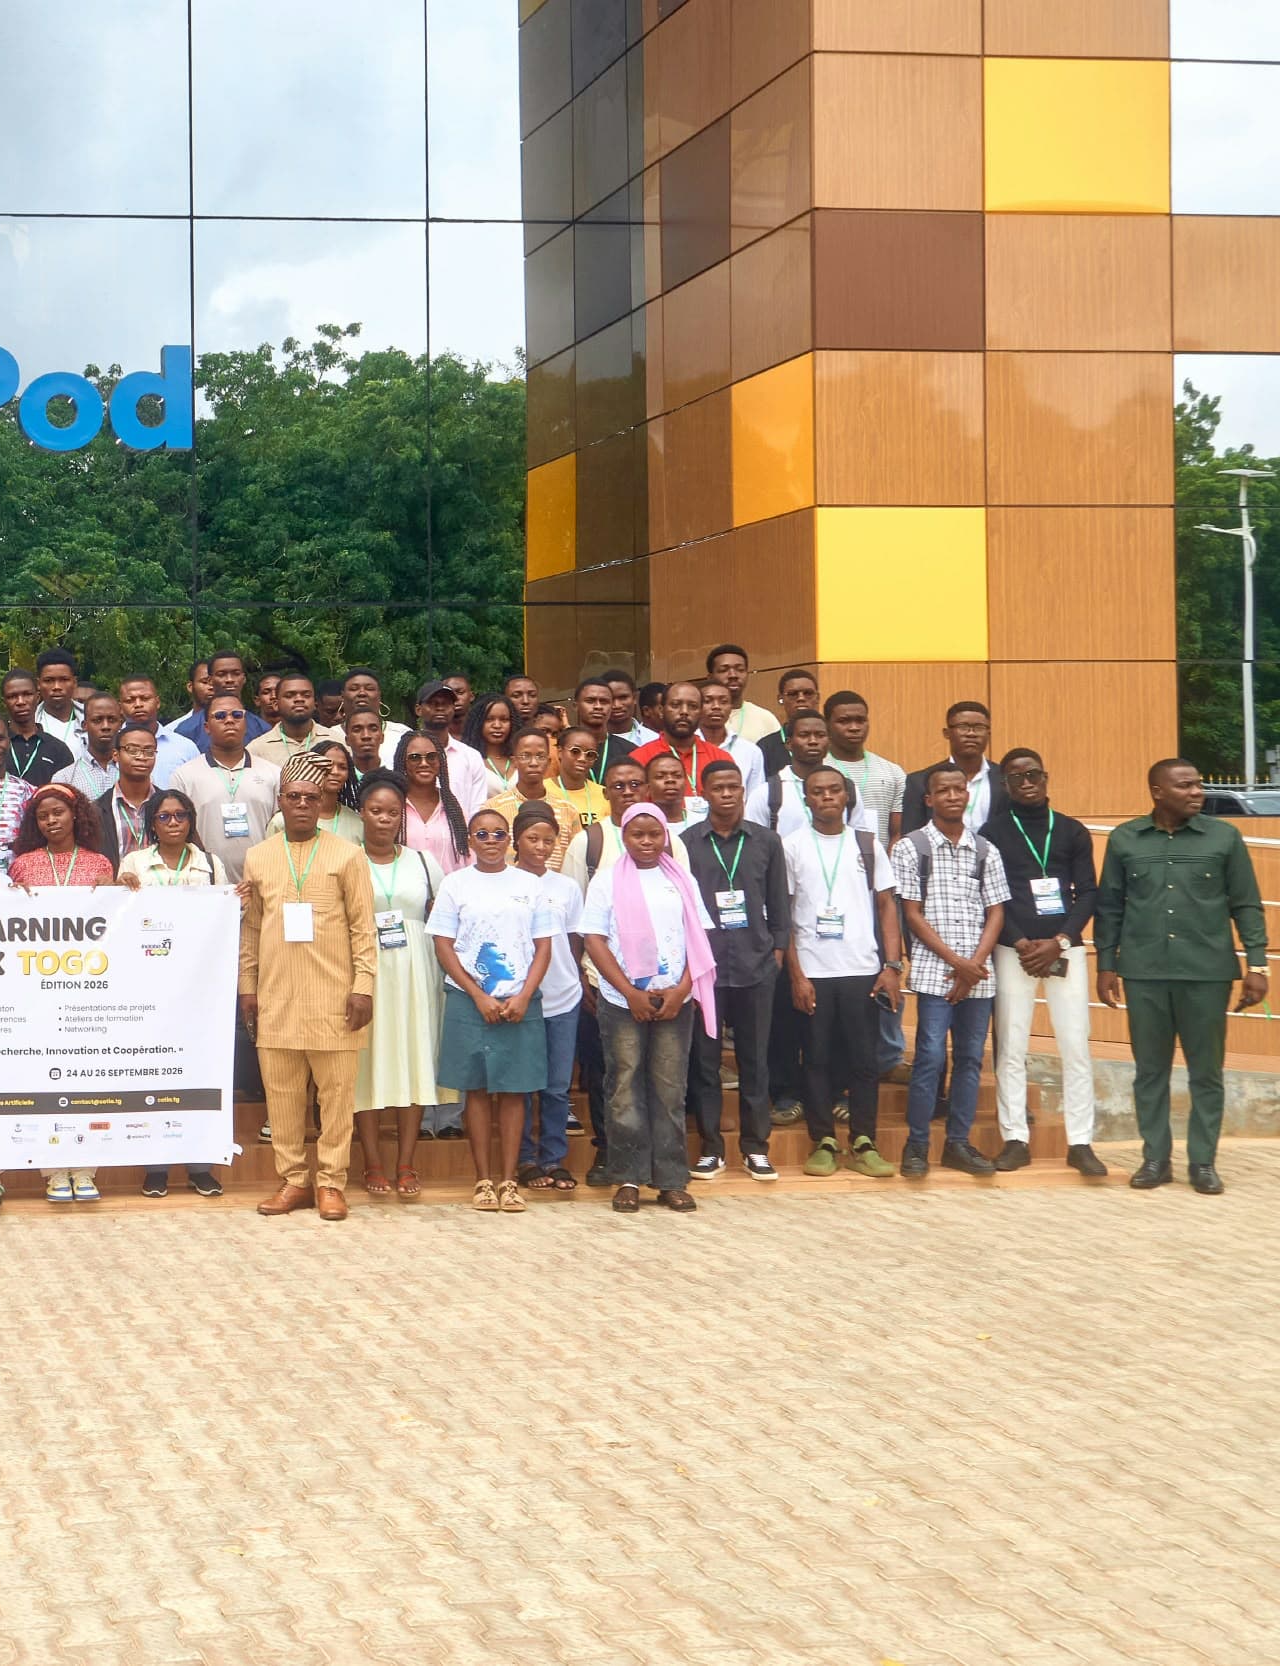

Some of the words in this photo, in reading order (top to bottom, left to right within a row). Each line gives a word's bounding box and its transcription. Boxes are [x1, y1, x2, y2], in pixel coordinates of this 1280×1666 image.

[17, 950, 109, 976] TOGO
[40, 979, 82, 990] ÉDITION
[84, 980, 109, 989] 2026
[64, 1004, 116, 1012] Présentations
[129, 1004, 156, 1013] projets
[106, 1014, 144, 1022] formation
[64, 1026, 108, 1034] Networking
[46, 1046, 99, 1055] Innovation
[101, 1047, 111, 1055] et
[113, 1045, 177, 1056] Coopération.
[66, 1069, 78, 1077] 24
[80, 1069, 93, 1077] AU
[95, 1068, 106, 1077] 26
[108, 1067, 159, 1077] SEPTEMBRE
[161, 1067, 183, 1075] 2026
